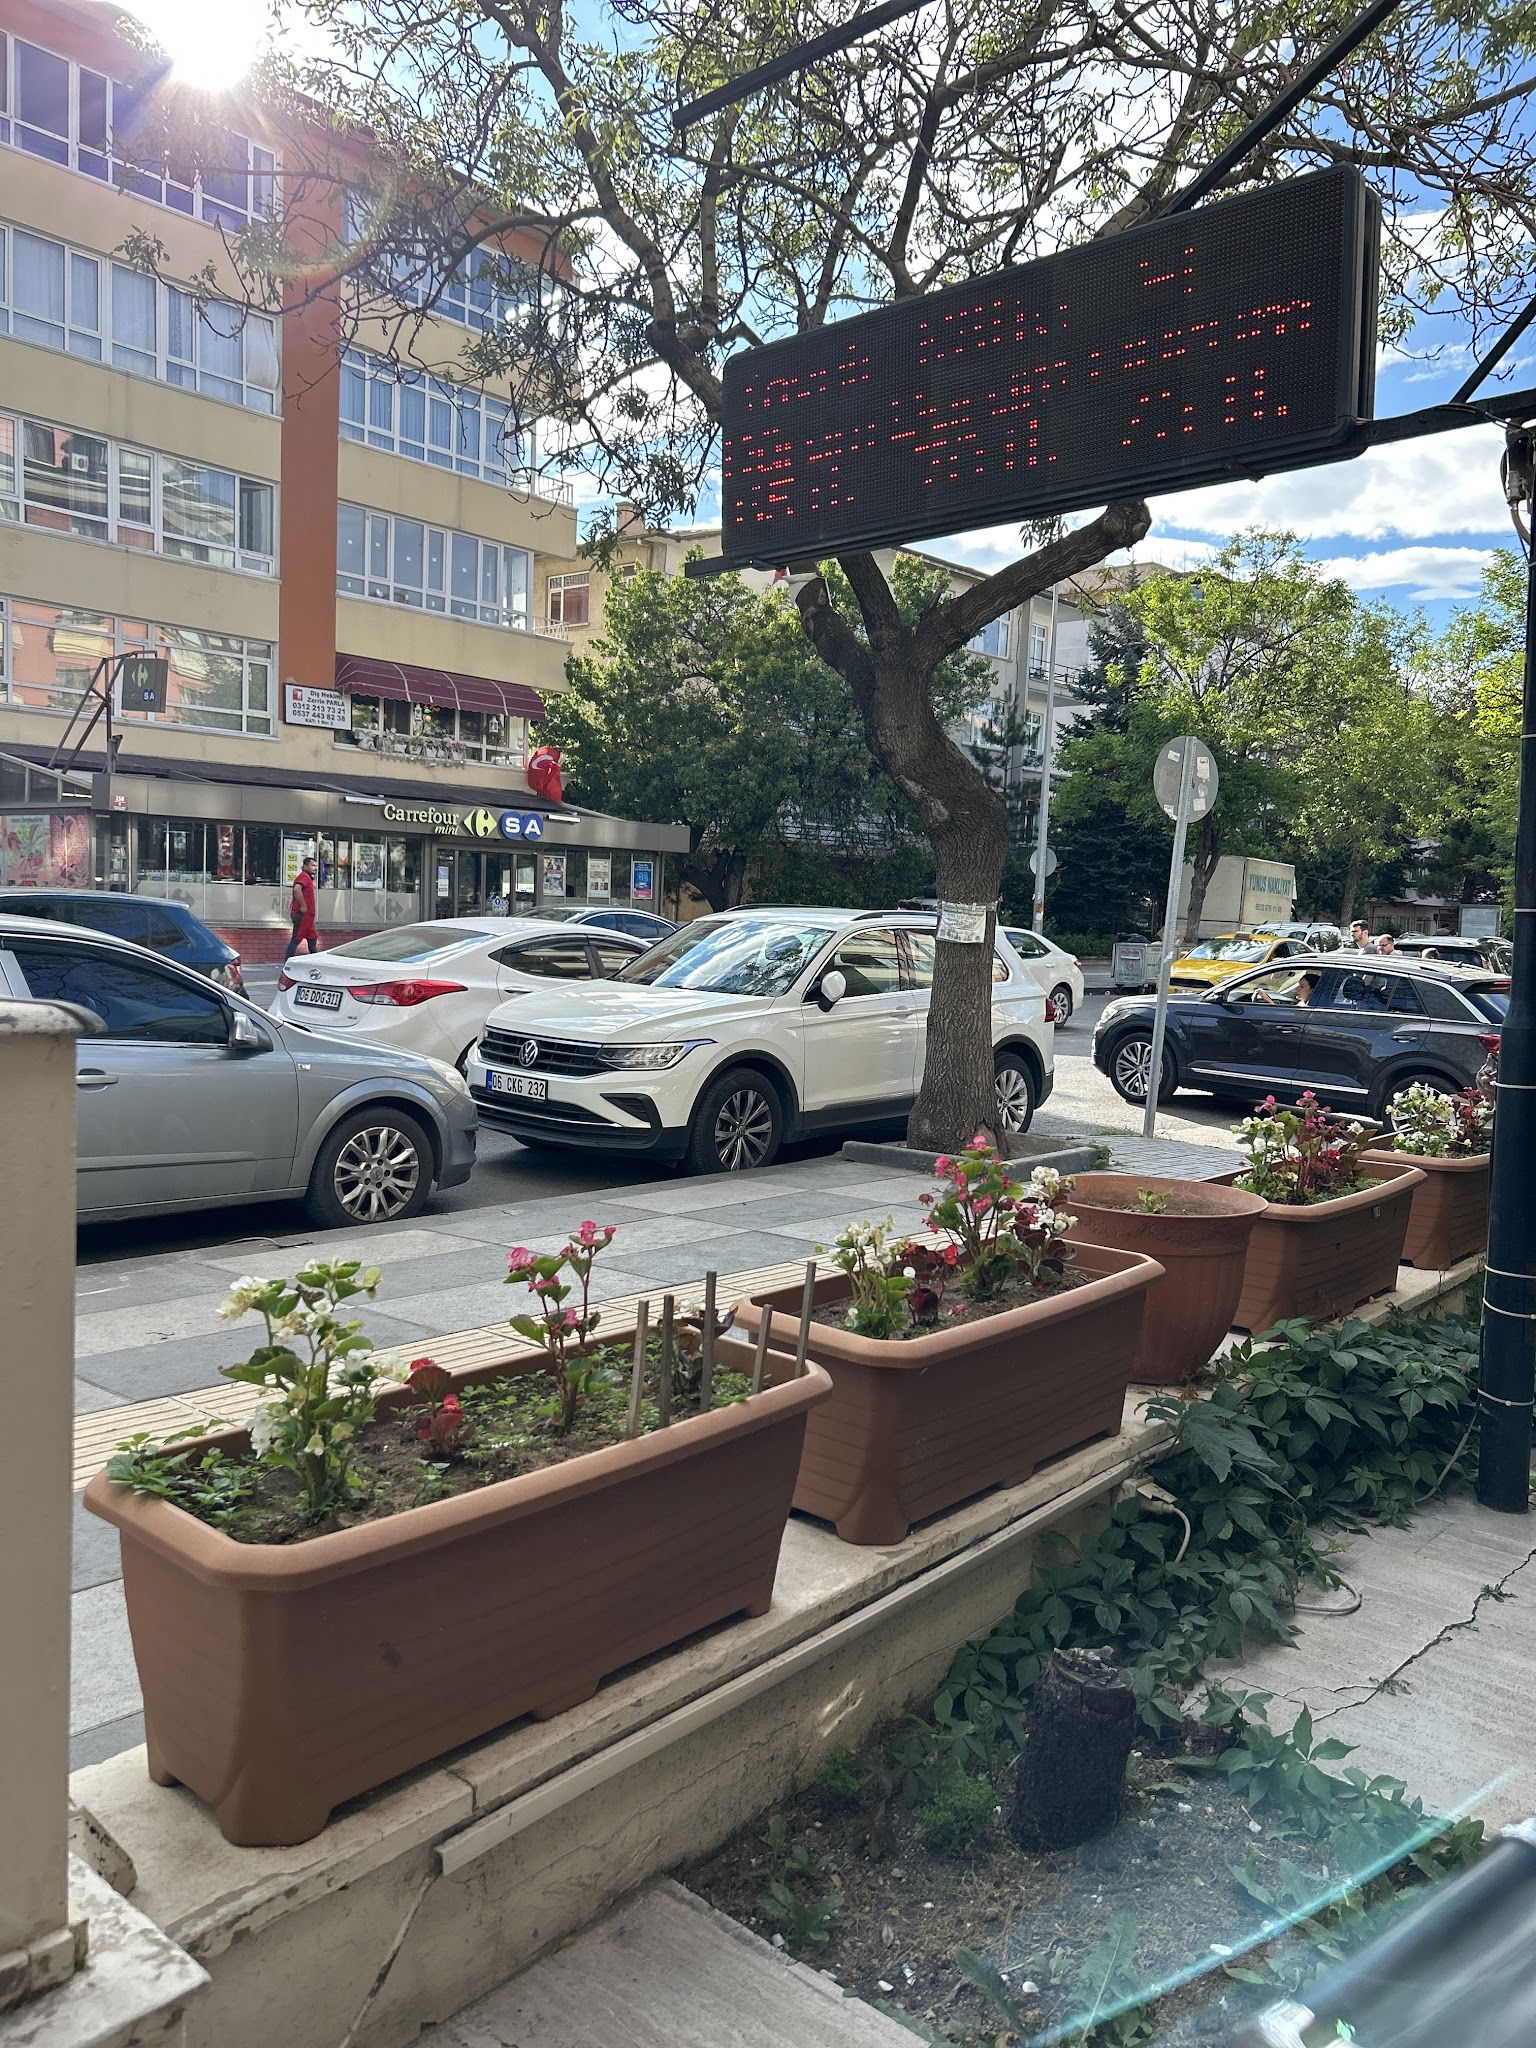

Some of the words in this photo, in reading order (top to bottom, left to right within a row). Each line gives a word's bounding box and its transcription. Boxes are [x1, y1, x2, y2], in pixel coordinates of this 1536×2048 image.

[143, 691, 155, 700] SA
[326, 699, 345, 707] PARLA
[312, 704, 325, 712] 213
[327, 706, 336, 714] 73
[383, 803, 460, 826] Carrefour
[504, 816, 542, 836] SA
[434, 823, 460, 836] mini
[1249, 874, 1267, 892] YUNUS
[300, 988, 310, 1001] 06
[310, 990, 326, 1004] DDG
[326, 992, 339, 1006] 311
[492, 1074, 503, 1090] 06
[507, 1077, 523, 1094] CKG
[528, 1080, 545, 1098] 232
